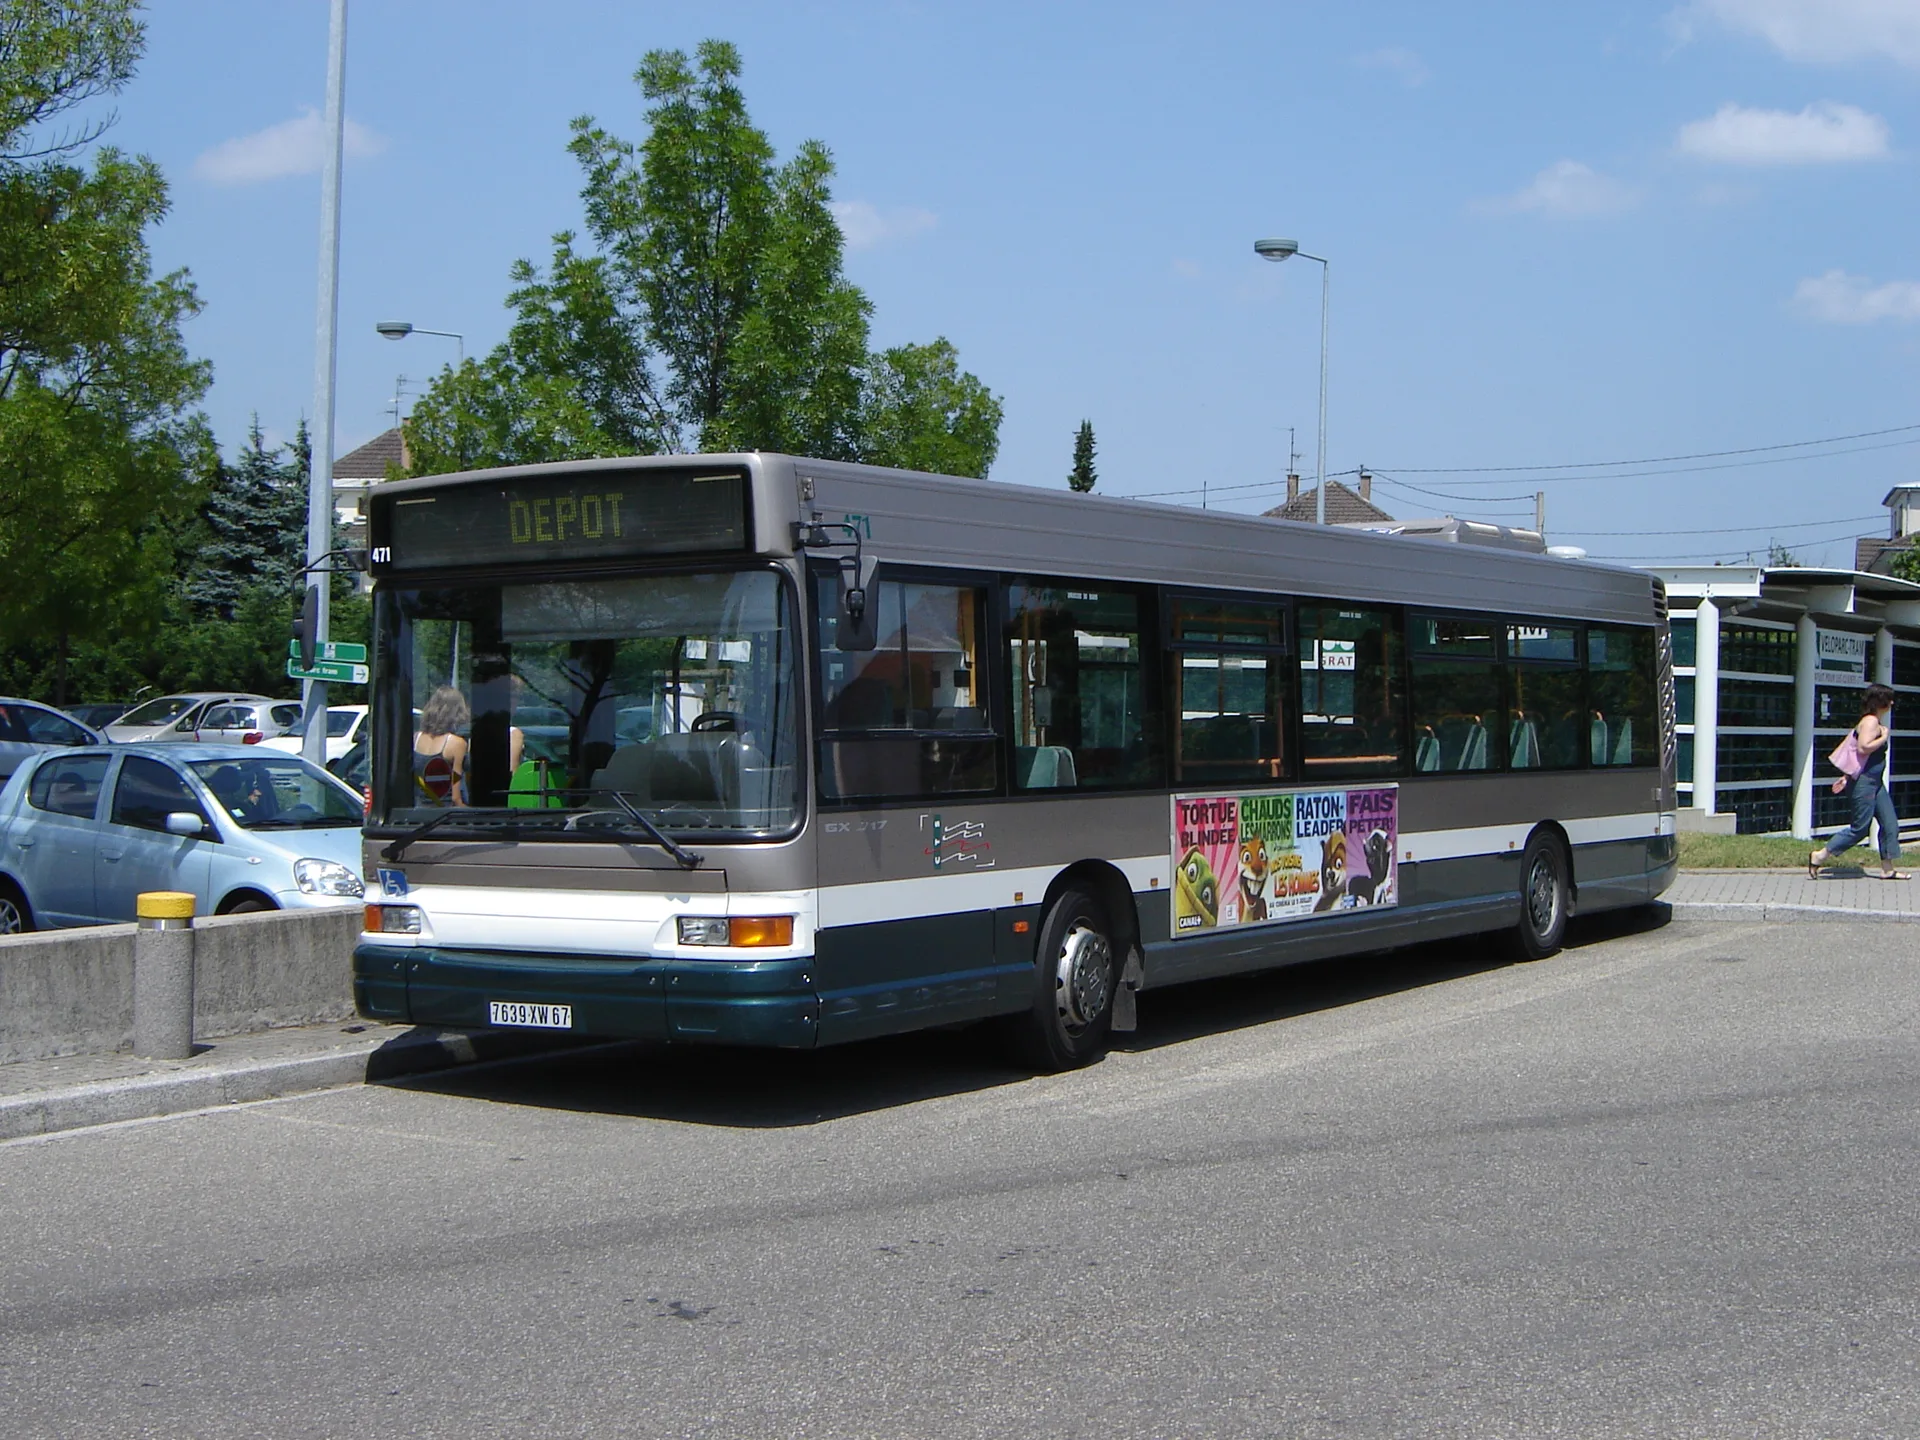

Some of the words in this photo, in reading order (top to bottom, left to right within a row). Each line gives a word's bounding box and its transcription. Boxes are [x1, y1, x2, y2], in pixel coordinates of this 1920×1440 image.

[510, 493, 623, 543] DEPOT
[372, 546, 391, 563] 471
[1181, 802, 1236, 825] TORTUE
[1241, 798, 1291, 821] CHAUDS
[1296, 796, 1344, 820] RATON-
[1349, 794, 1394, 815] FAIS
[824, 822, 850, 833] GX
[1181, 825, 1236, 848] BLINDÉE
[1179, 916, 1202, 928] CANAL+
[492, 1003, 526, 1023] 7639
[530, 1005, 548, 1024] XW
[552, 1007, 568, 1025] 67
